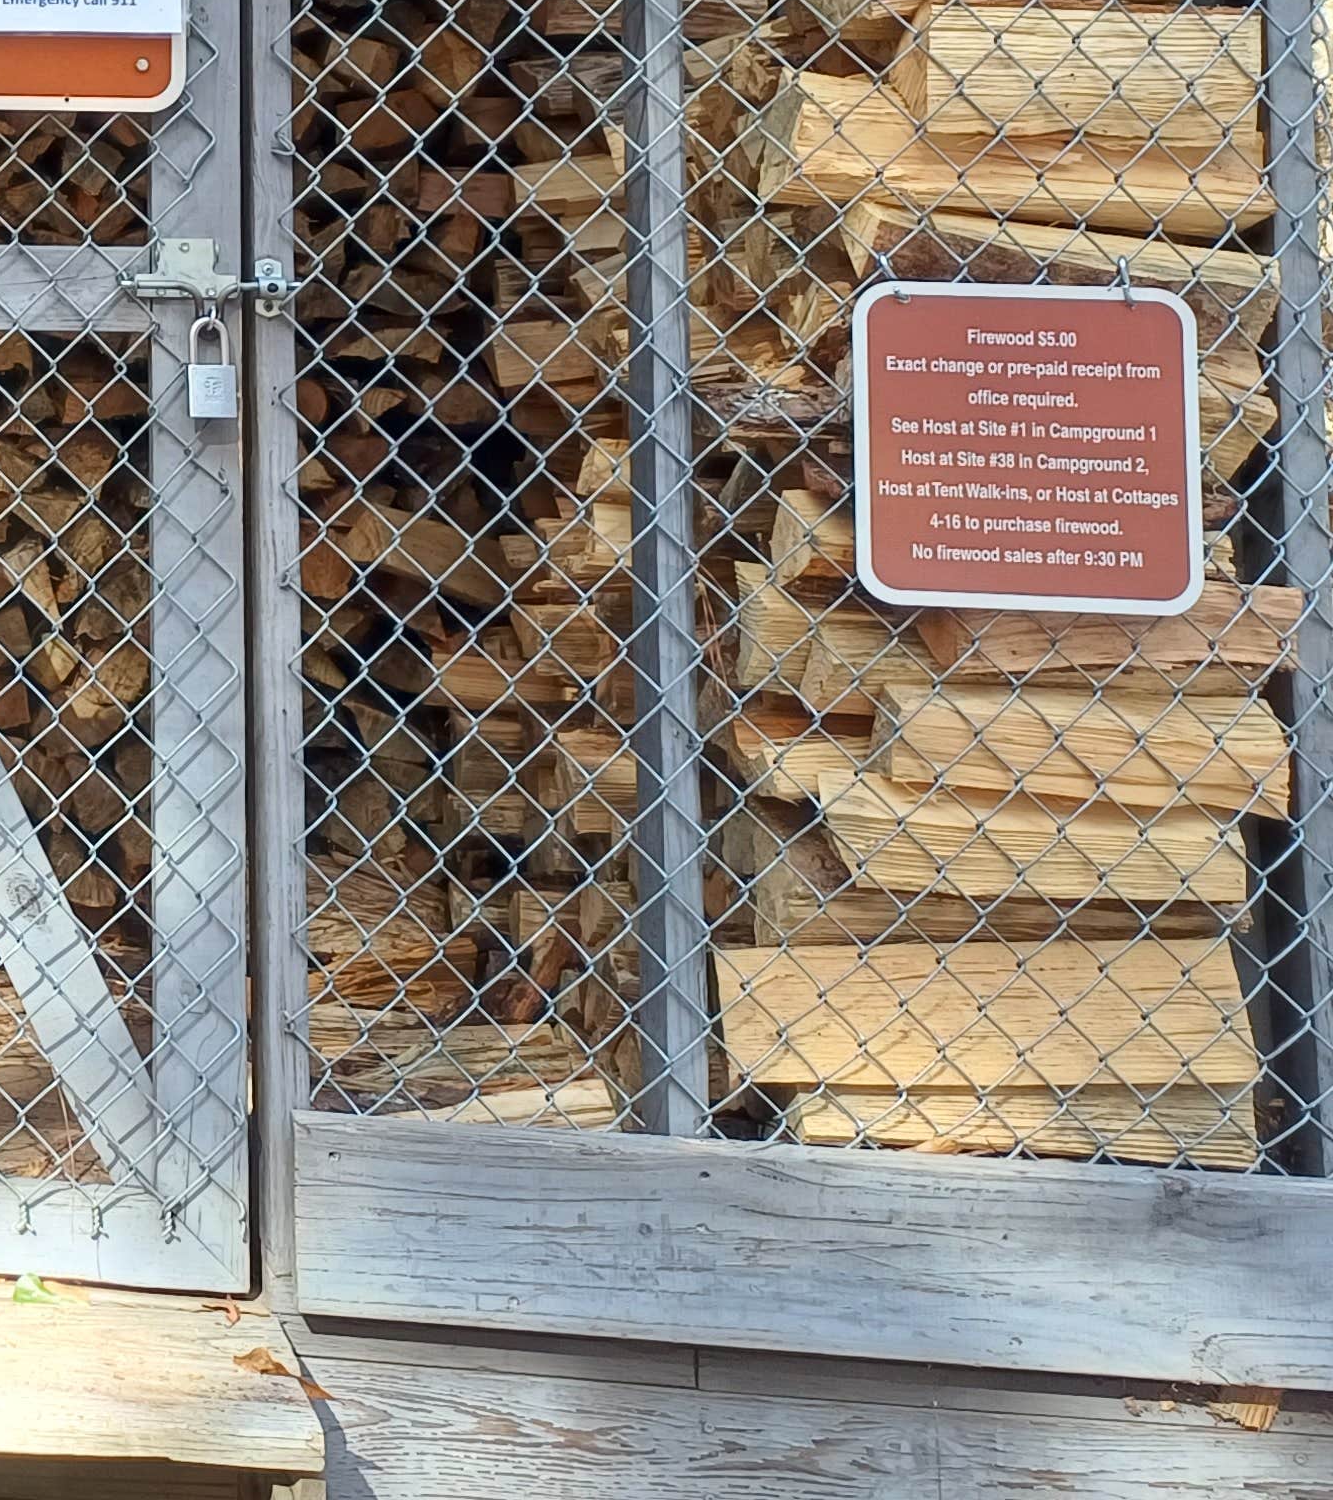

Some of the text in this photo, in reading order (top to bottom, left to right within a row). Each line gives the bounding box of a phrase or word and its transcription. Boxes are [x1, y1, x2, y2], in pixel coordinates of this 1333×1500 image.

[967, 329, 1077, 347] Firewood $5.00
[886, 356, 1160, 380] Exact change or pre-paid receipt from
[968, 390, 1079, 410] office required.
[891, 417, 1156, 443] See Host at Site #1 in Campground 1
[902, 450, 1149, 475] Host at Site #38 in Campground 2,
[878, 480, 1178, 508] Host at Tent Walk-ins, or Host at Cottages
[930, 513, 1123, 535] 4-16 to purchase firewood.
[912, 543, 1142, 567] No firewood sales after 9:30 PM
